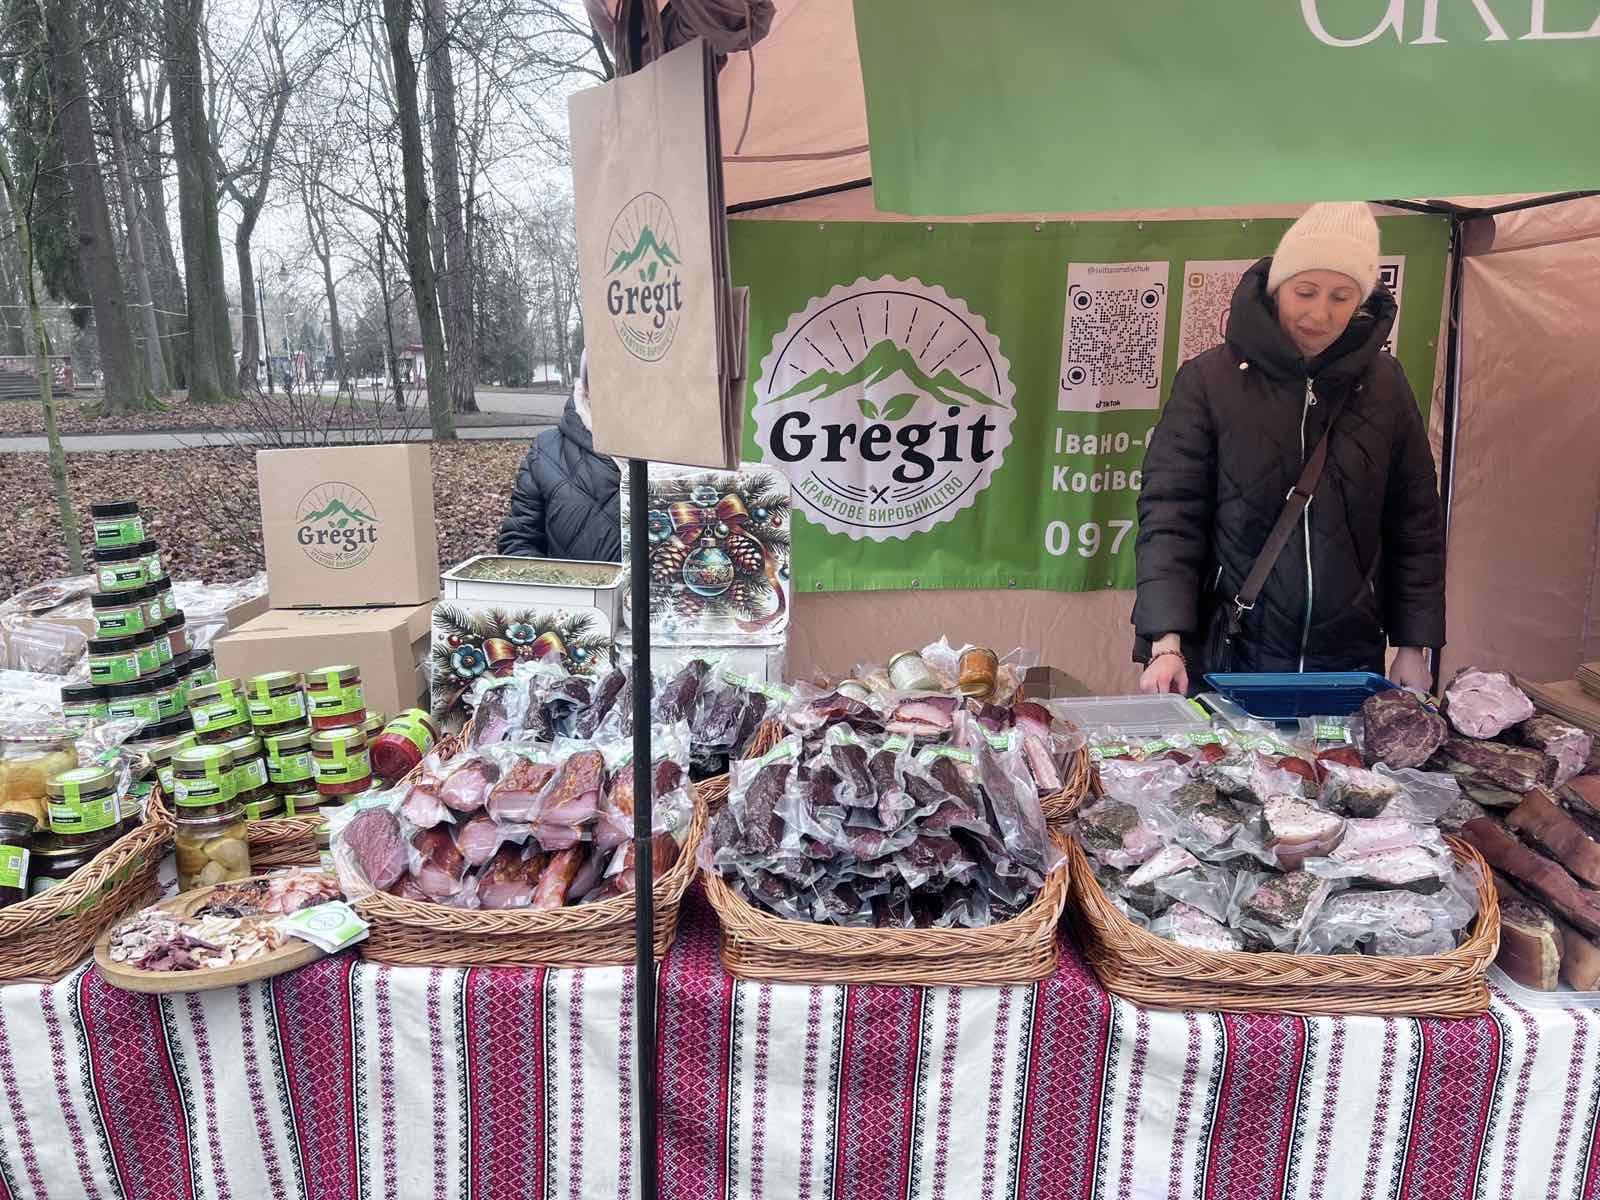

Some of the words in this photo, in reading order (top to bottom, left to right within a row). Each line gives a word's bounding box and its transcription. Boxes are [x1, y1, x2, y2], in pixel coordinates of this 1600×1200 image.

[607, 268, 682, 328] Gregit
[769, 406, 996, 483] Gregit
[800, 477, 864, 520] КРАФТОВЕ
[869, 476, 964, 522] ВИРОБНИЦТВО
[297, 522, 378, 552] Gregit
[1044, 520, 1134, 557] 097
